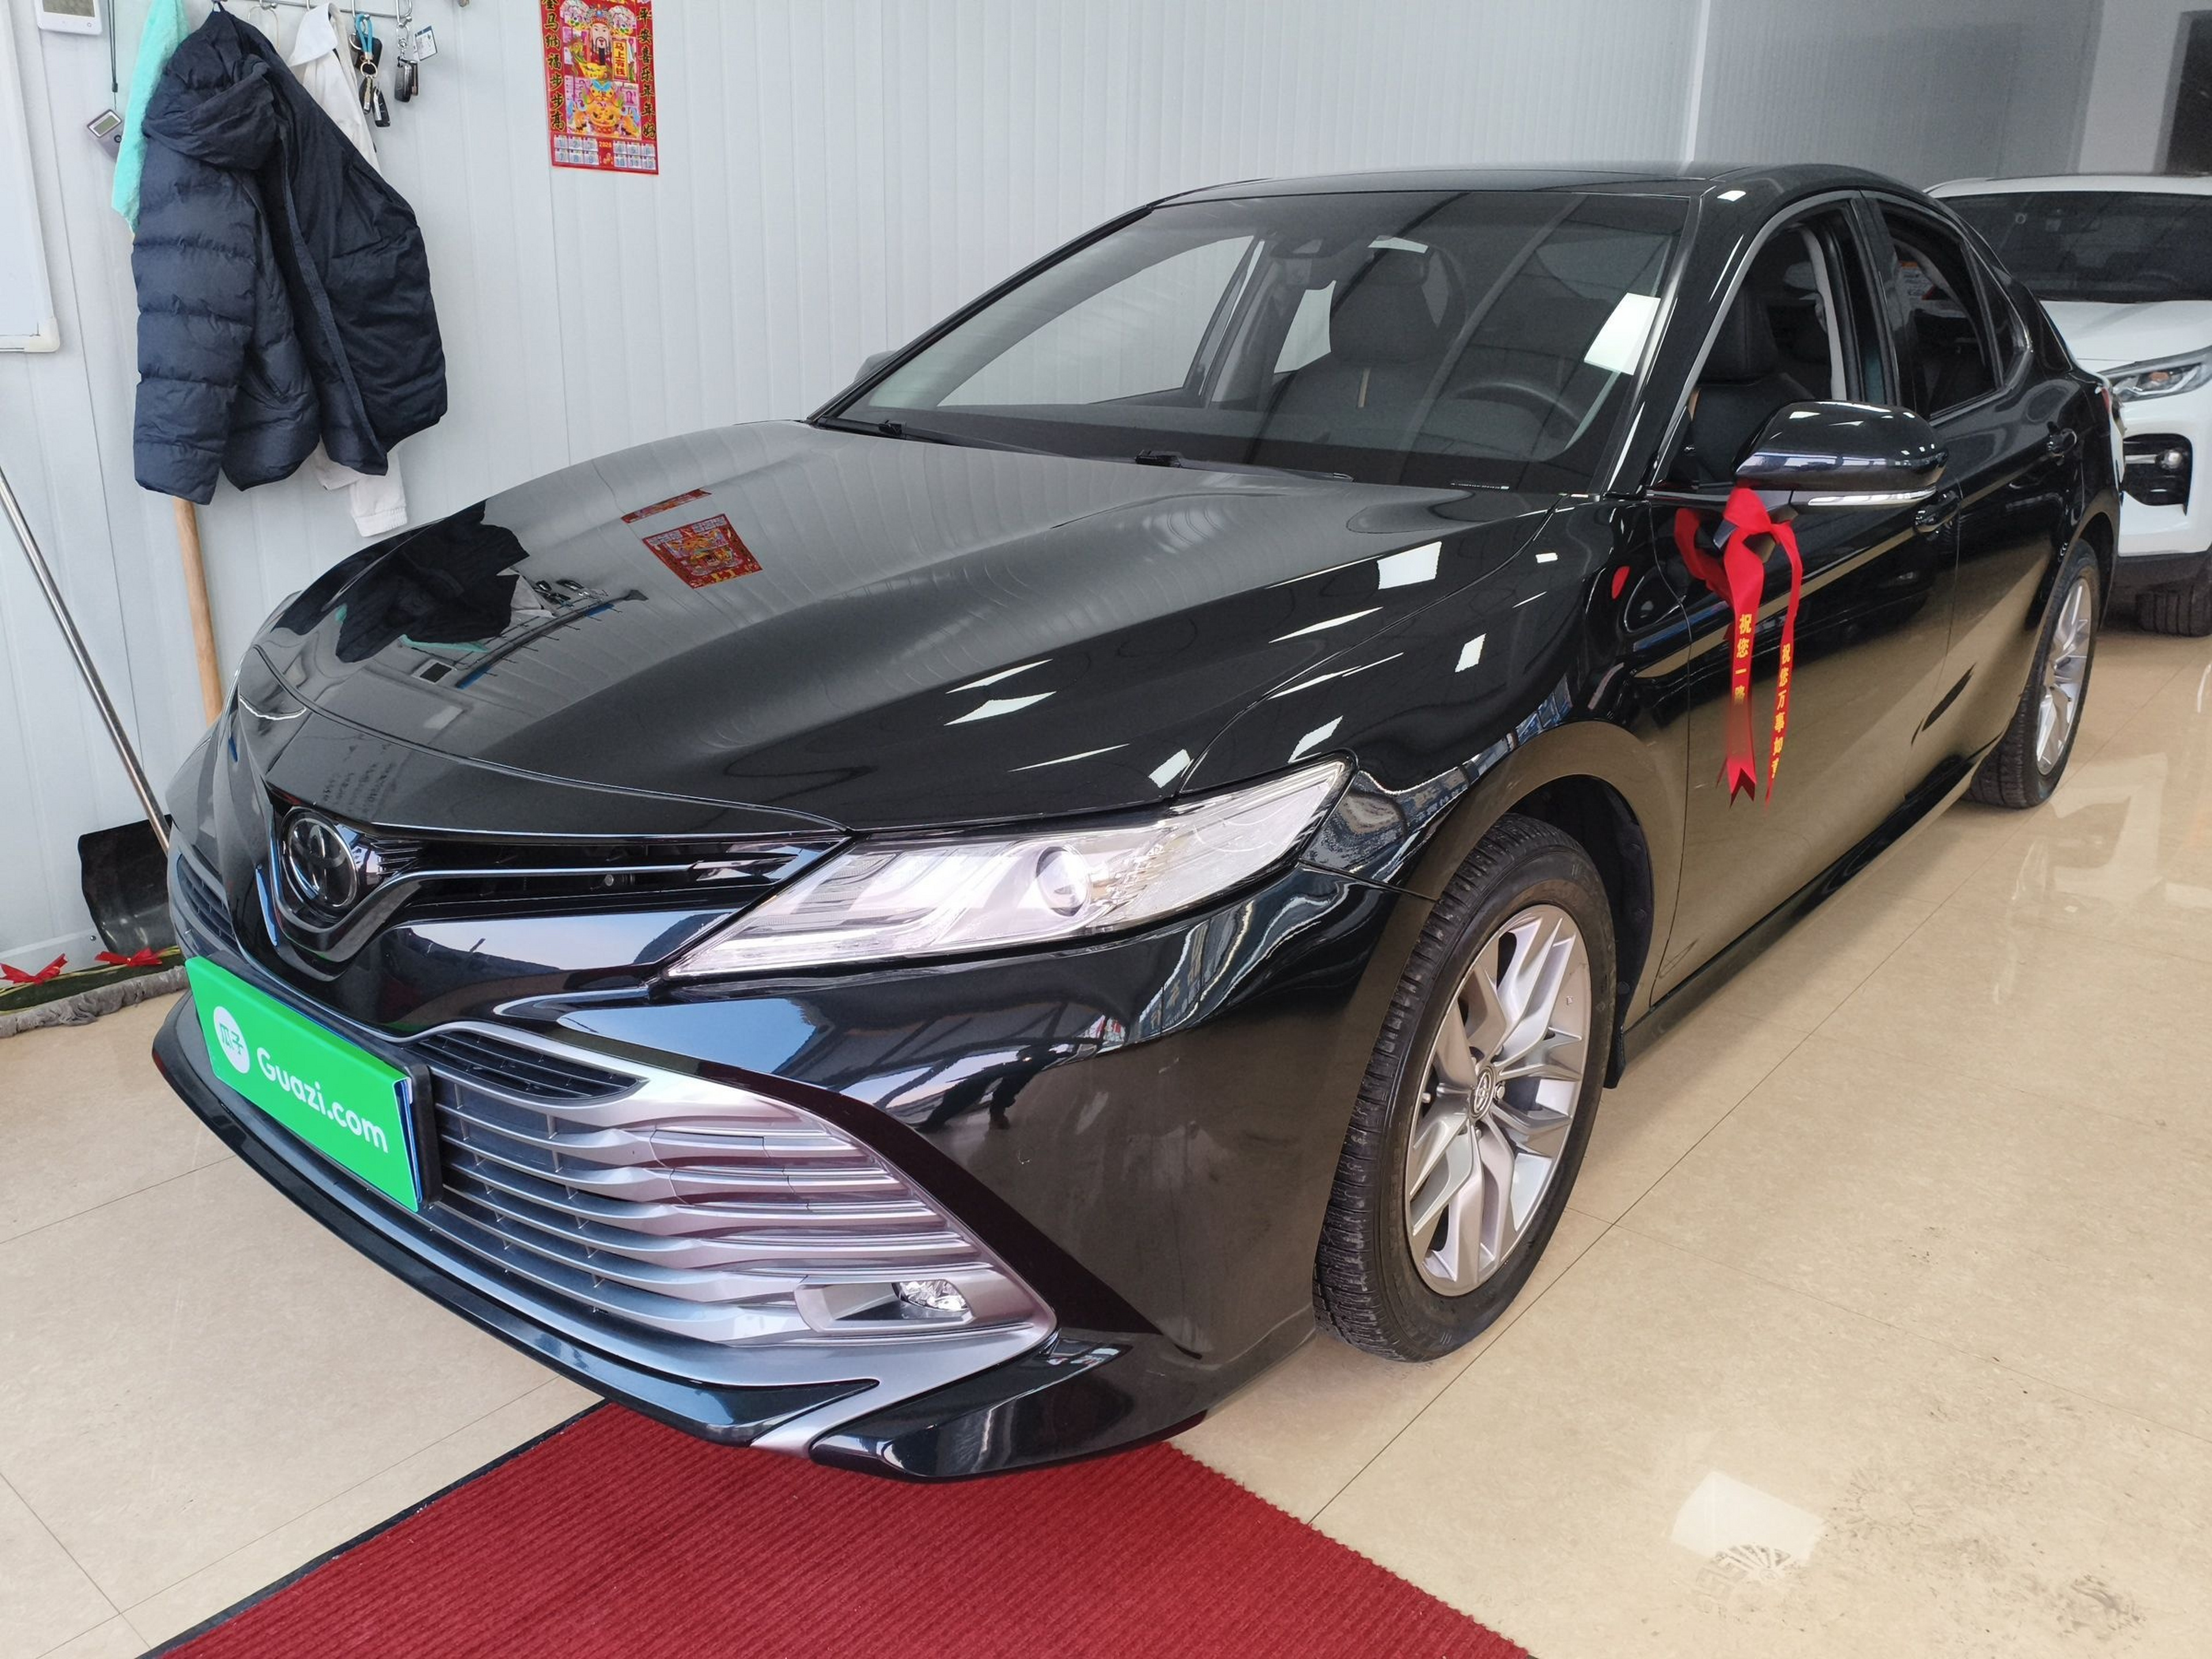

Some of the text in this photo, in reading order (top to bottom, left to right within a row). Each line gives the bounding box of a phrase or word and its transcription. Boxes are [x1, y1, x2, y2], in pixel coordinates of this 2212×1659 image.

[637, 7, 656, 139] 平安喜乐年年好
[219, 1022, 244, 1055] 瓜子
[257, 1047, 389, 1153] Guazi.com
